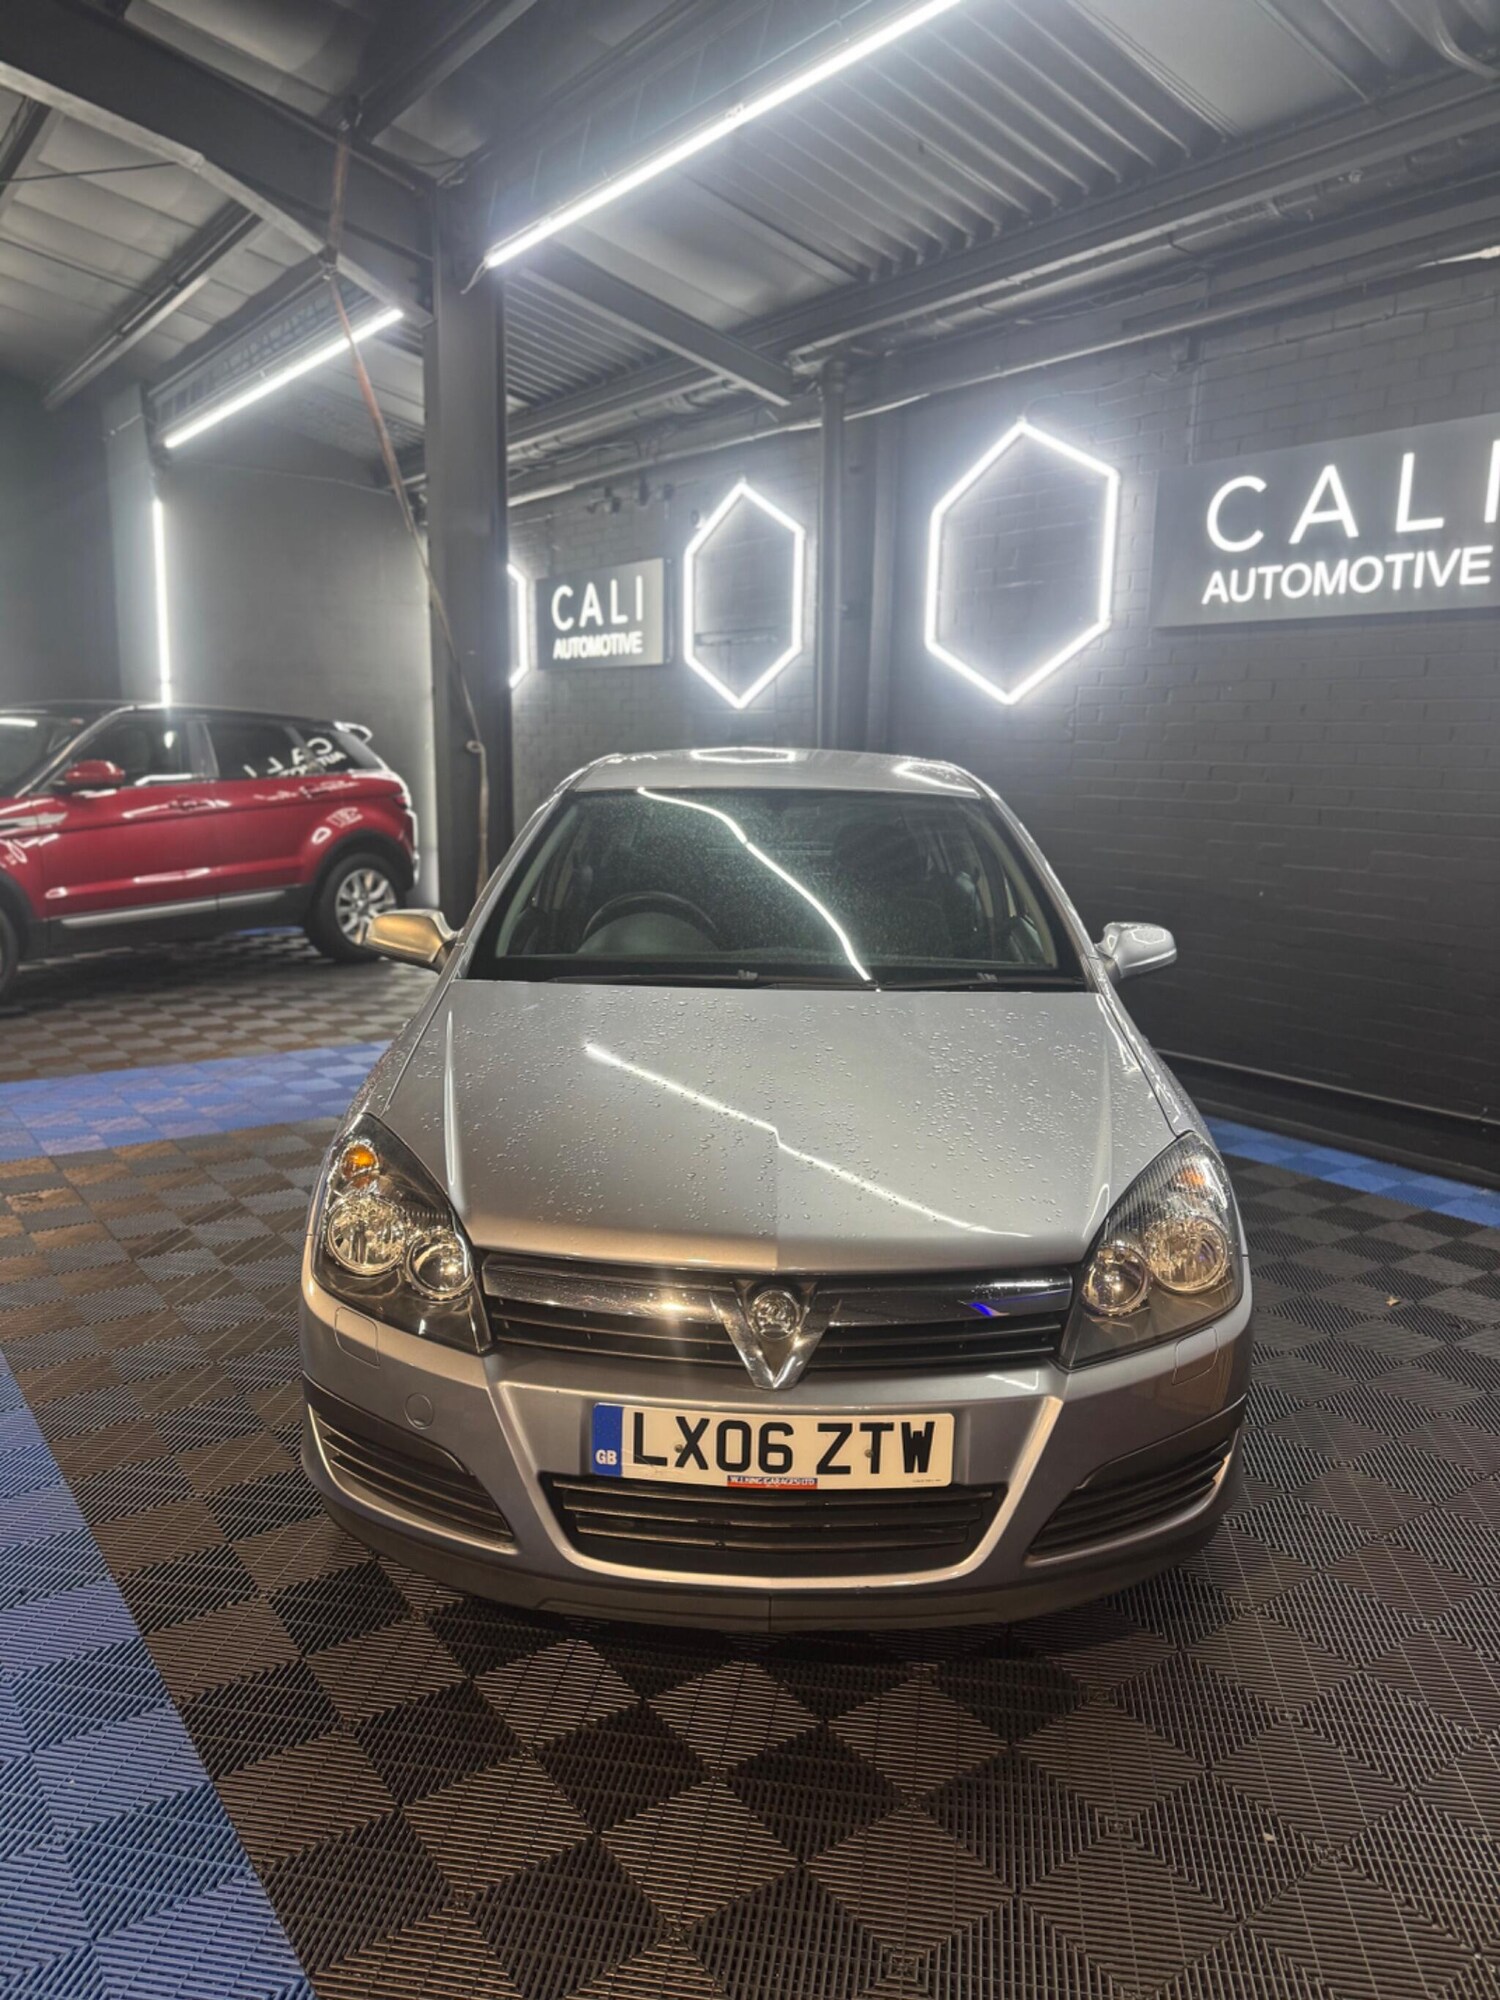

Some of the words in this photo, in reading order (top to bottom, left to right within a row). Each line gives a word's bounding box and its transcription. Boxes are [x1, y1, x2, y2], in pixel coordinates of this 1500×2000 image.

[1206, 439, 1500, 552] CALI
[551, 575, 643, 631] CALI
[1200, 545, 1494, 605] AUTOMOTIVE
[552, 631, 643, 660] AUTOMOTIVE
[595, 1449, 618, 1465] GB
[632, 1411, 794, 1474] LX06
[815, 1421, 936, 1475] ZTW
